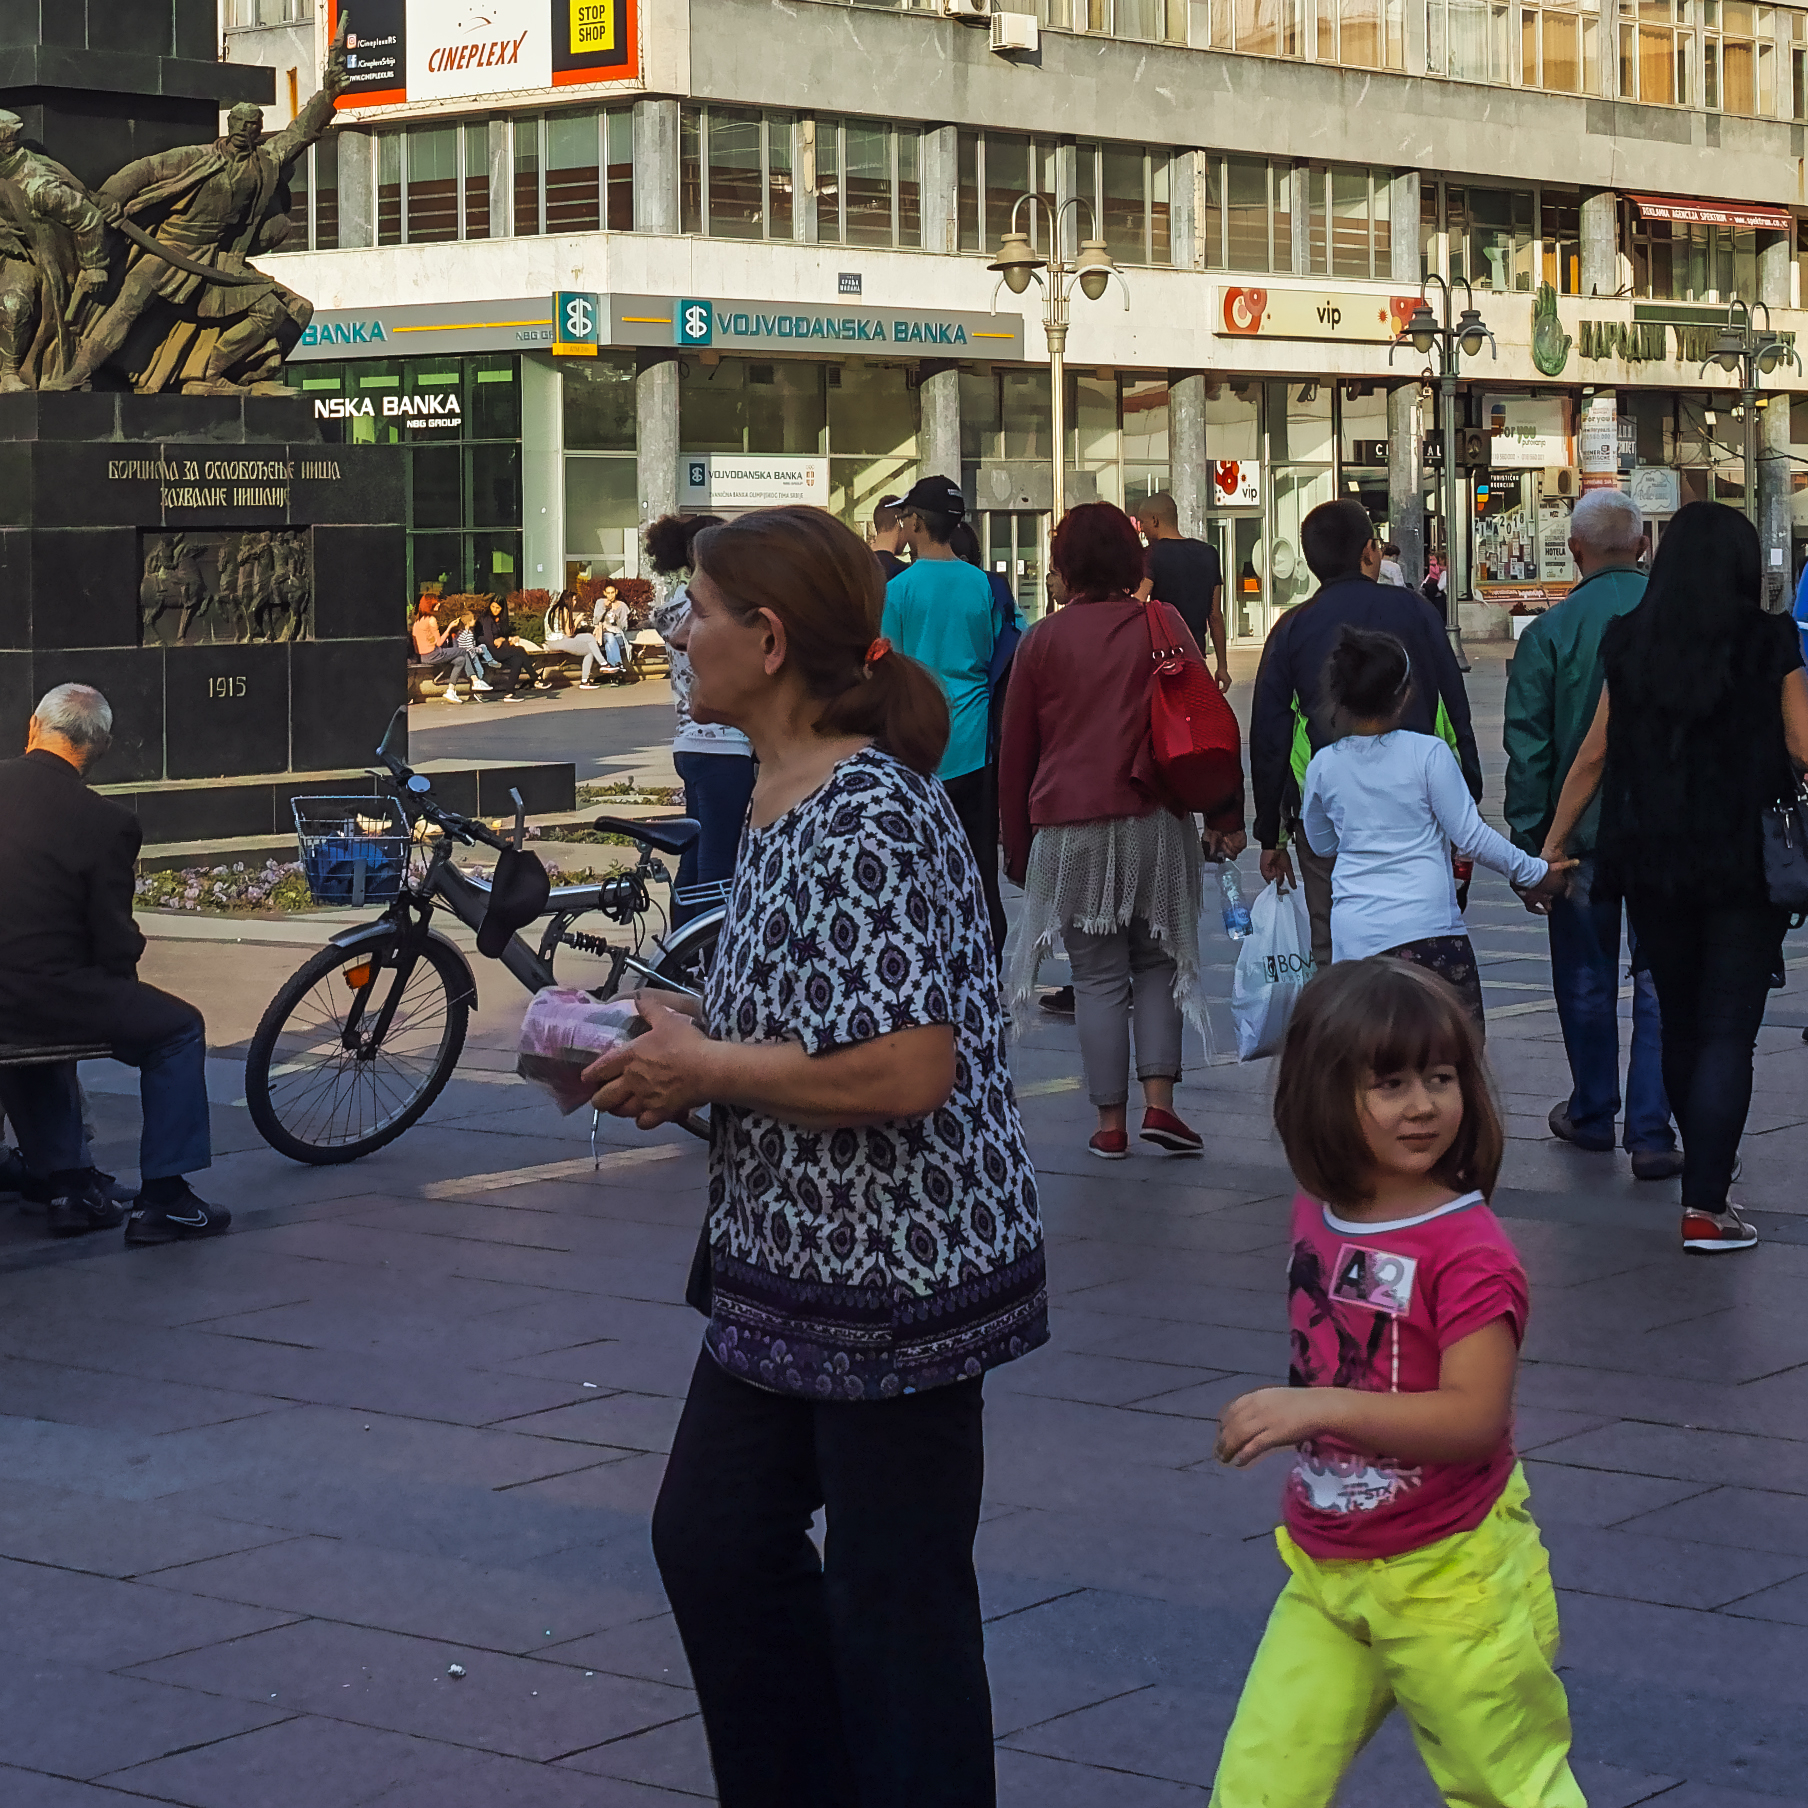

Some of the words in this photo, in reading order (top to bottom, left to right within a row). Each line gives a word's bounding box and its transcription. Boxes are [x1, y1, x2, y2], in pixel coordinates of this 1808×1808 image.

[578, 4, 606, 22] STOP
[579, 25, 606, 42] SHOP
[428, 30, 528, 73] CINEPLEXX
[1316, 300, 1341, 330] vip
[301, 320, 387, 346] BANKA
[515, 330, 539, 341] NBG
[717, 313, 886, 342] VOJVOĐANSKA
[893, 321, 967, 344] BANKA
[382, 394, 461, 417] BANKA
[406, 419, 427, 428] NBG
[429, 418, 462, 428] GROUP
[182, 461, 200, 480] ЗА
[205, 461, 295, 481] ОСЛОБОЂЕЊЕ
[301, 461, 341, 480] НИША
[774, 471, 803, 480] BANKA
[1242, 484, 1257, 502] vip
[208, 677, 247, 698] 1915
